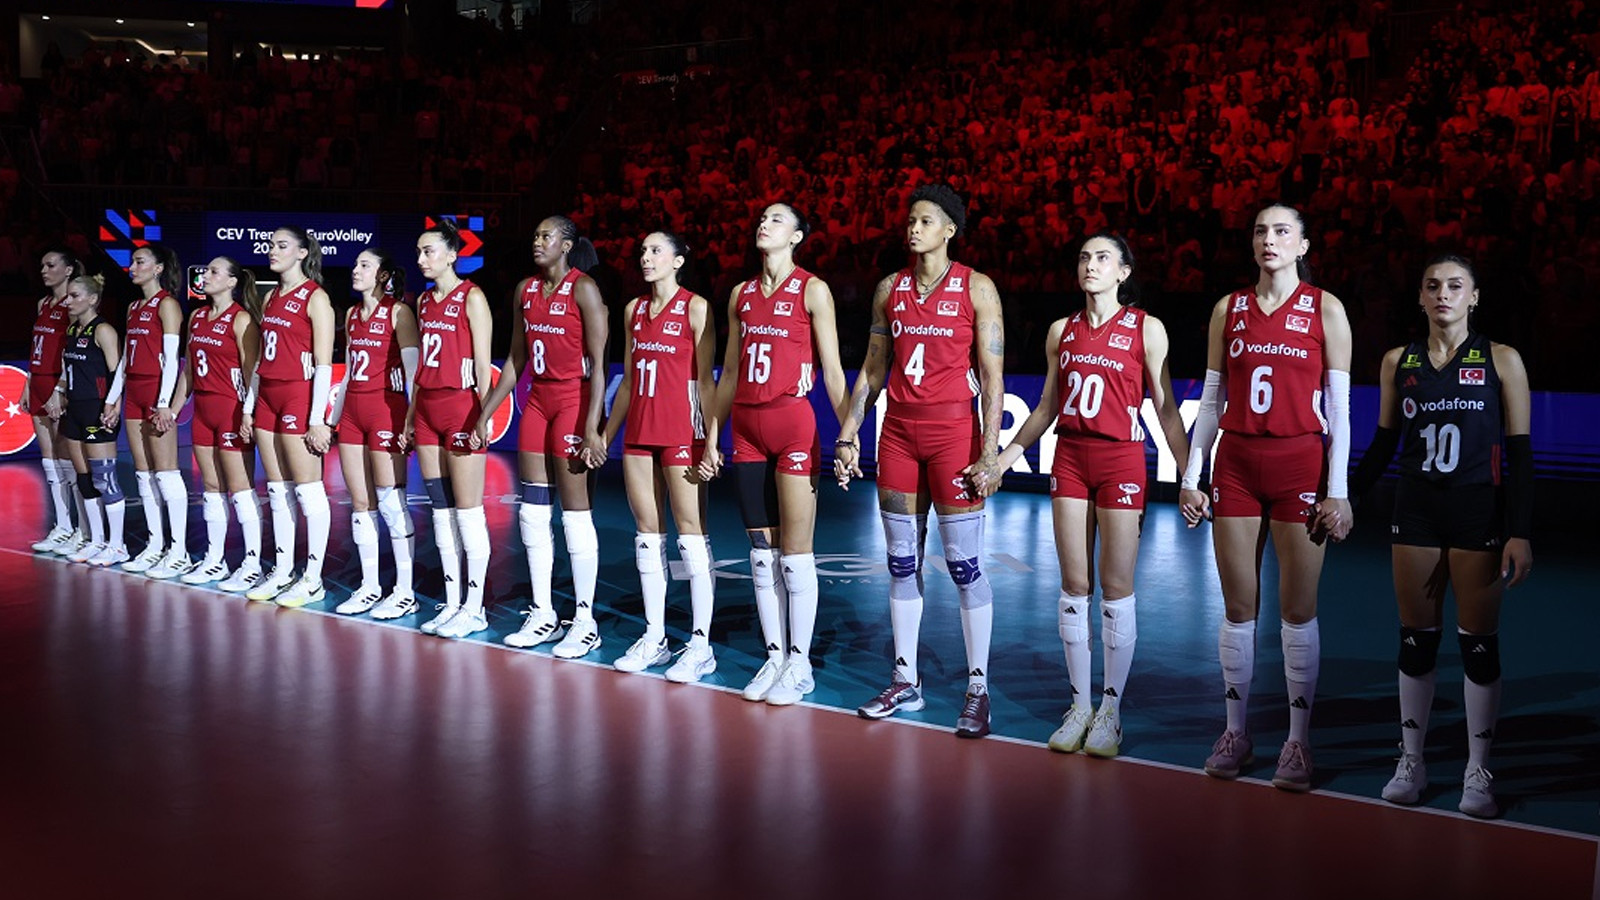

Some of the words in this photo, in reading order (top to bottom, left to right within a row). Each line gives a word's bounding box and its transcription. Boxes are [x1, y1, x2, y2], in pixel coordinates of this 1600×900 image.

[216, 228, 244, 240] CEV
[253, 241, 270, 254] 20
[529, 323, 565, 335] vodafone
[747, 324, 789, 338] vodafone
[903, 324, 954, 338] vodafone
[129, 339, 137, 367] 7
[263, 329, 278, 361] 18
[422, 333, 442, 368] 12
[533, 339, 545, 375] 8
[637, 341, 677, 354] vodafone
[1246, 342, 1308, 359] vodafone
[196, 349, 209, 378] 3
[747, 342, 772, 385] 15
[904, 342, 925, 386] 4
[1071, 353, 1125, 372] vodafone
[67, 364, 73, 390] 1
[636, 358, 658, 398] 11
[1250, 365, 1273, 414] 6
[1063, 370, 1105, 419] 20
[1420, 397, 1485, 412] vodafone
[1419, 423, 1460, 473] 10
[1213, 487, 1219, 503] 6
